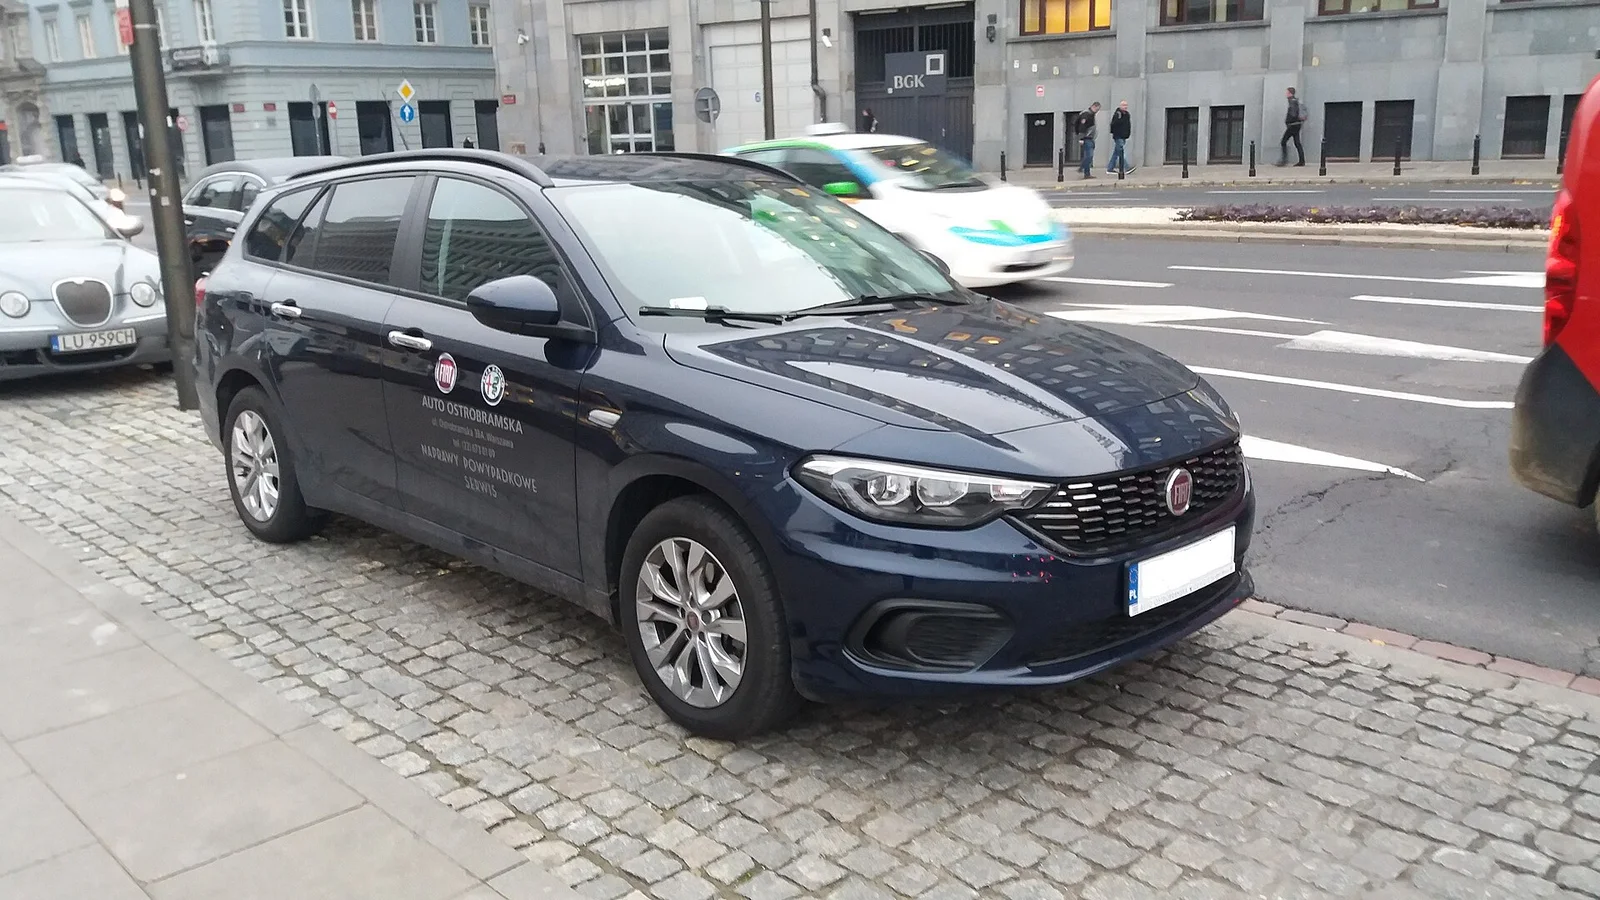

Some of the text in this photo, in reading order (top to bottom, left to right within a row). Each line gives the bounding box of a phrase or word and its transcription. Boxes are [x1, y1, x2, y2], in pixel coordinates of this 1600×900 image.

[893, 74, 925, 89] BGK
[755, 91, 761, 103] 6
[62, 329, 134, 350] LU 959CH
[422, 395, 524, 435] AUTO OSTROBRAMSKA
[421, 444, 538, 493] NAPRAWY POWYPADKOWE
[464, 475, 498, 498] SERWIS
[1128, 589, 1138, 600] PL
